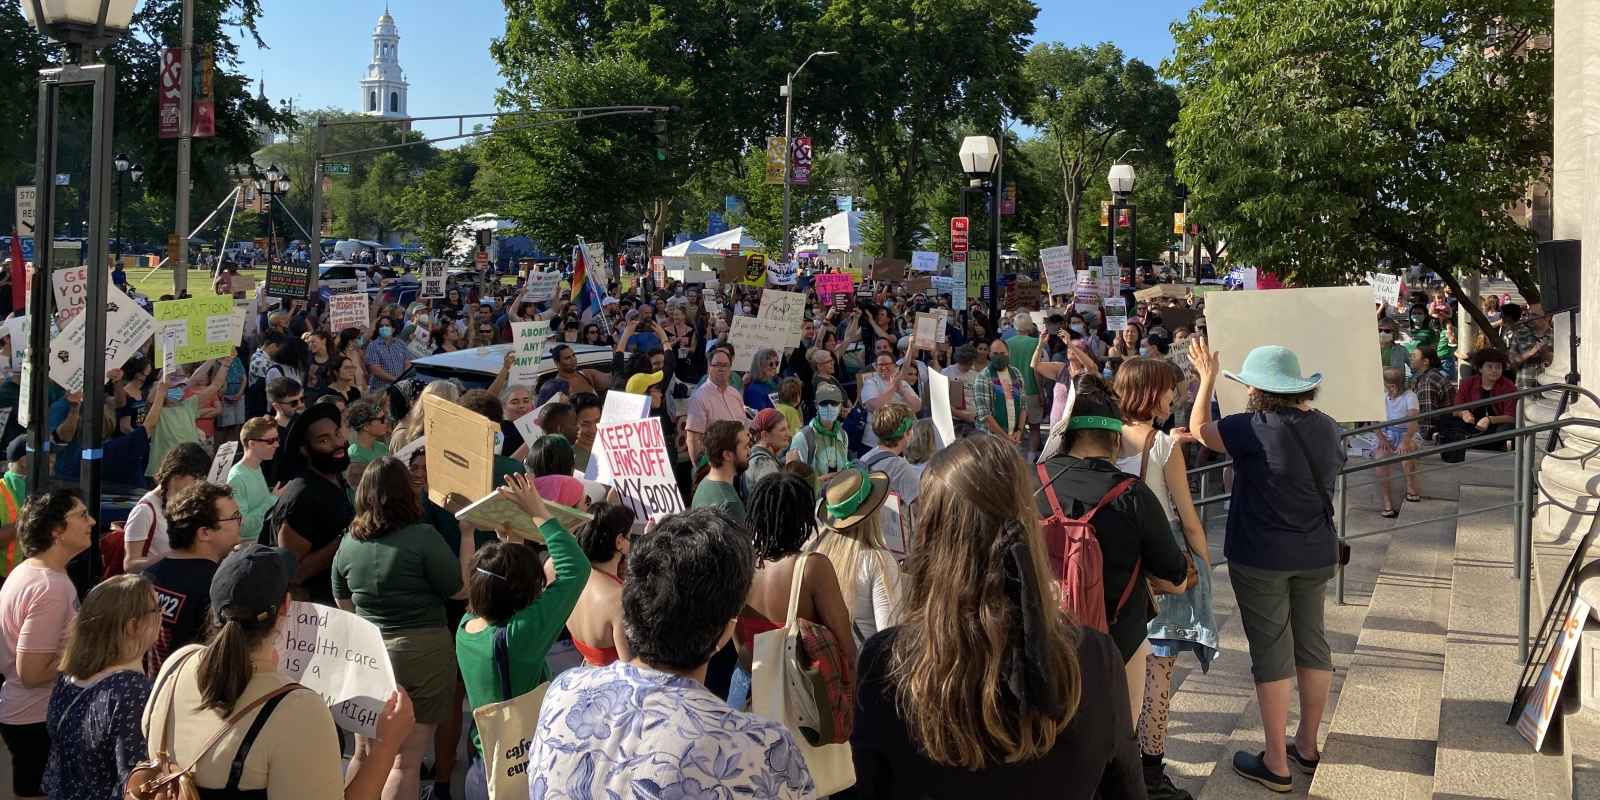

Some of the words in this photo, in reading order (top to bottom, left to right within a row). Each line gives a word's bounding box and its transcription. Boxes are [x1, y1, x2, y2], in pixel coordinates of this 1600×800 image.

[20, 191, 36, 200] STO
[955, 221, 964, 229] No
[64, 269, 87, 283] GE
[523, 341, 539, 352] ANY
[513, 357, 532, 368] ANY
[598, 424, 632, 450] KEEP
[632, 418, 665, 450] YOUR
[606, 449, 642, 476] LAWS
[639, 448, 665, 476] OFF
[612, 478, 649, 521] MY
[643, 483, 685, 513] BODY
[297, 612, 328, 629] and
[286, 631, 339, 657] health
[344, 649, 381, 670] care
[311, 663, 321, 679] a
[340, 700, 377, 726] RIGH
